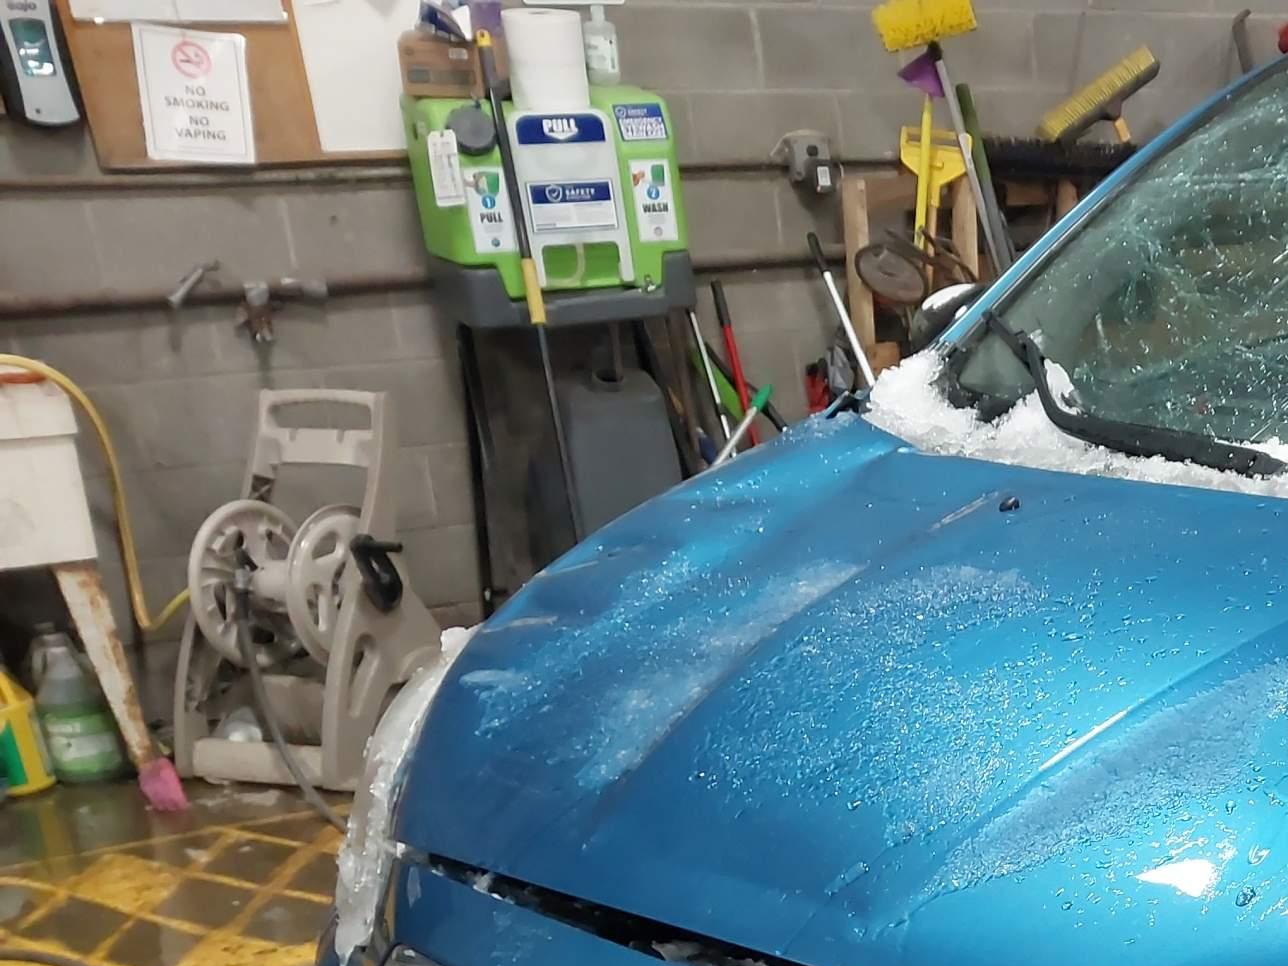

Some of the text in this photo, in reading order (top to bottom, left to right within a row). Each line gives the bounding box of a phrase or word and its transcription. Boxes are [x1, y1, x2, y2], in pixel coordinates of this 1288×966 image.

[185, 85, 206, 97] NO
[164, 96, 229, 112] SMOKING
[189, 115, 209, 126] NO
[542, 118, 578, 133] PULL
[175, 128, 226, 141] VAPING
[642, 202, 669, 213] WASH
[480, 211, 503, 223] PULL
